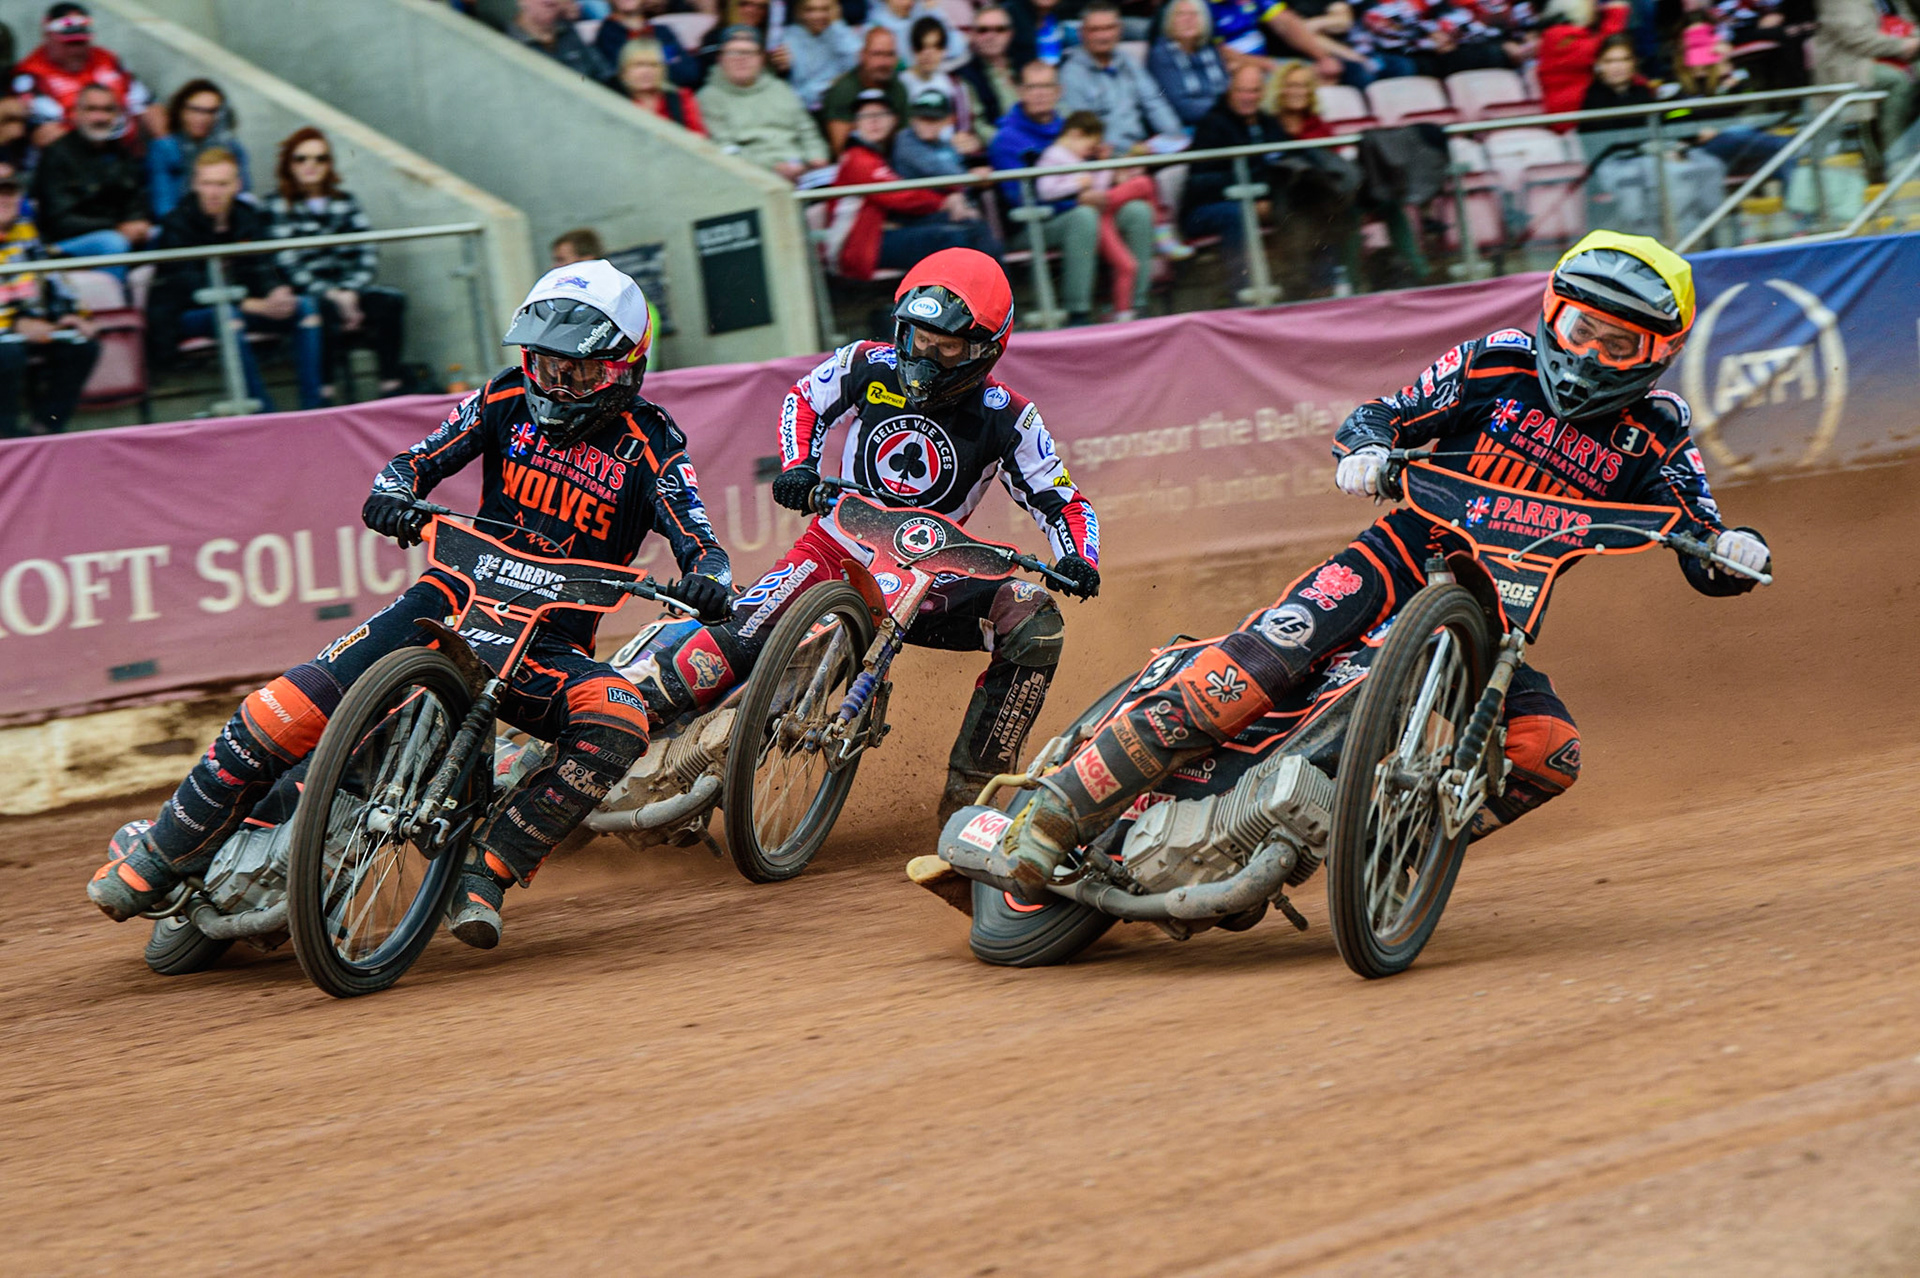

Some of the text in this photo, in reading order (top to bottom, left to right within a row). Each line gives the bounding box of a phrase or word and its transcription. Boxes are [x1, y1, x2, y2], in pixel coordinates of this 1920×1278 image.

[1491, 332, 1526, 346] 100%
[623, 439, 639, 460] 1
[872, 420, 953, 470] BELLE VUE ACES
[1518, 408, 1623, 483] PARRYS
[1621, 426, 1640, 452] 3
[502, 457, 616, 541] WOLVES
[902, 519, 921, 531] BELLE
[923, 519, 936, 528] VUE
[1491, 495, 1593, 537] PARRYS
[498, 558, 567, 592] PARRYS
[1495, 578, 1539, 602] RGE
[0, 545, 171, 638] OFT
[739, 559, 817, 637] WESSEXMARINE
[1299, 588, 1338, 611] GPS
[457, 627, 516, 646] JWP
[1270, 615, 1311, 635] 45
[1140, 656, 1176, 686] 3
[997, 671, 1045, 762] SCOTT BROWN
[556, 766, 608, 800] RACING
[1081, 749, 1118, 795] NGK
[505, 805, 527, 829] Mike
